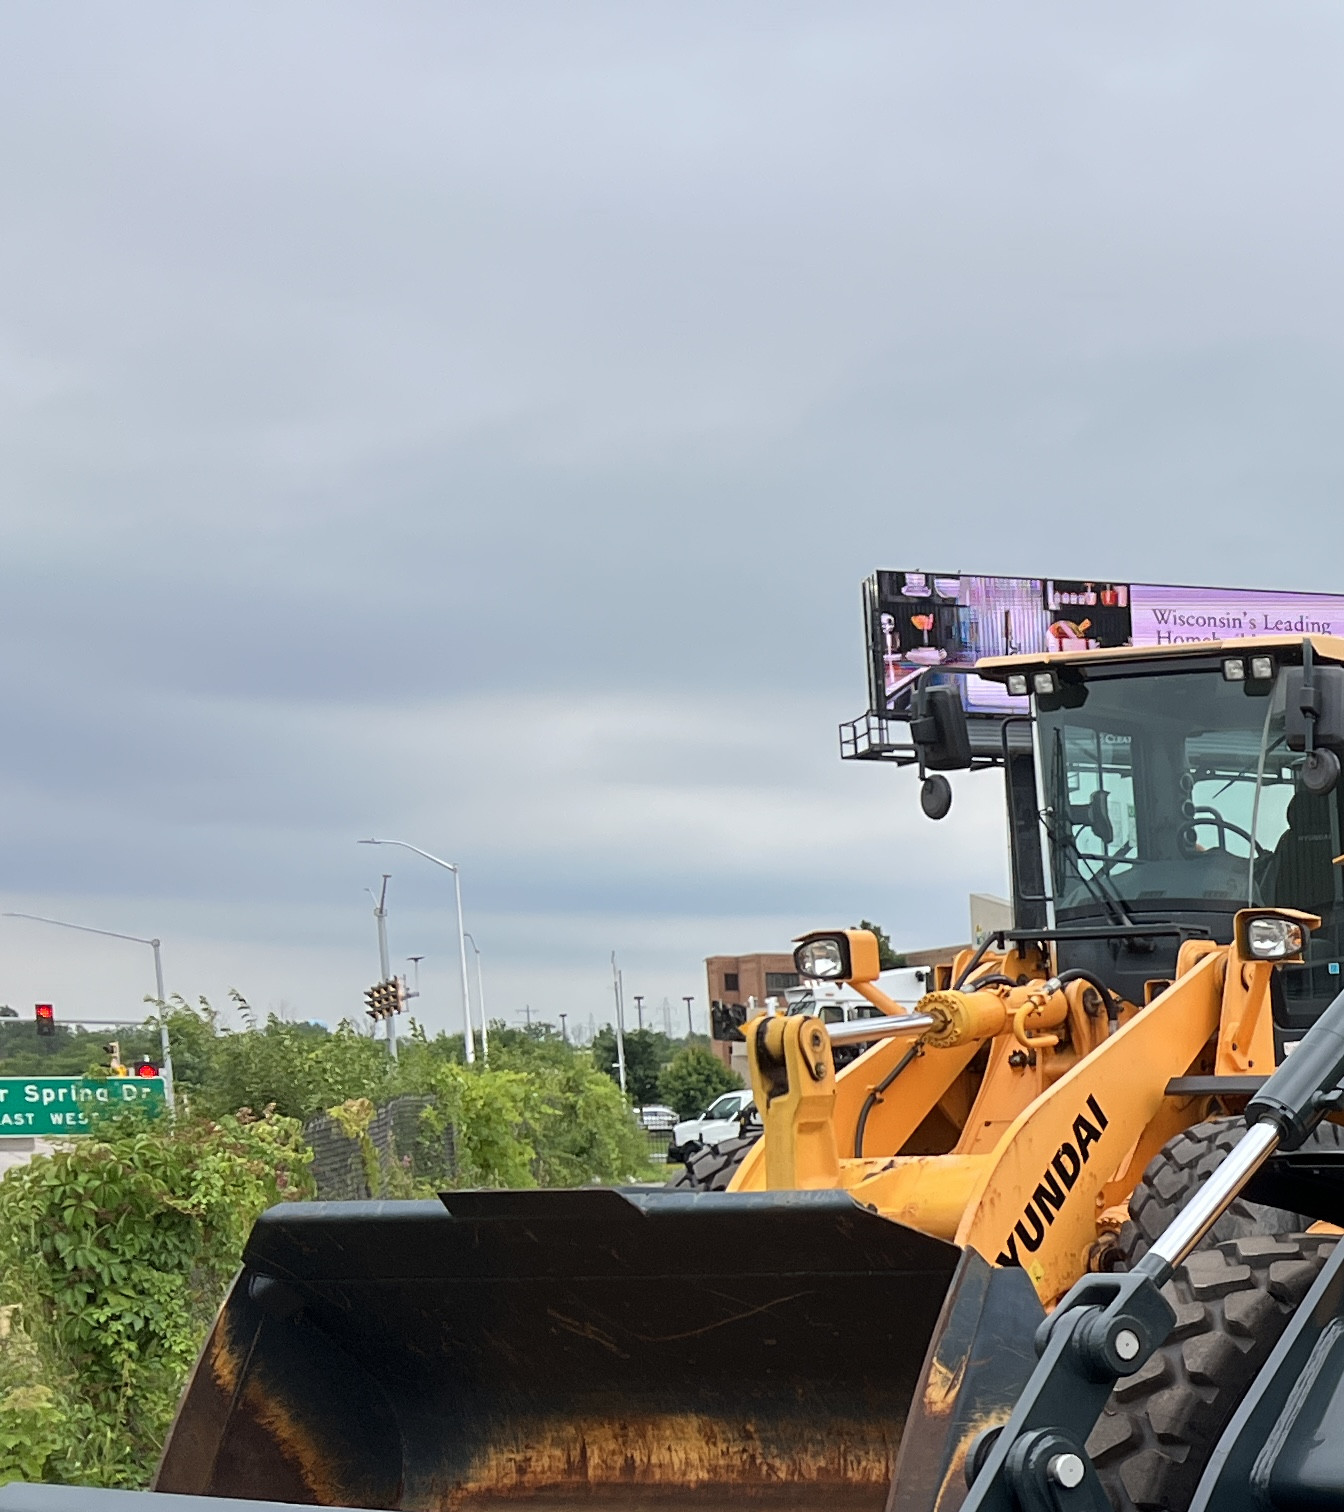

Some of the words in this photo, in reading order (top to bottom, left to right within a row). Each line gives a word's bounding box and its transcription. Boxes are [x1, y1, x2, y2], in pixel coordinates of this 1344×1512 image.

[1152, 608, 1257, 631] Wisconsin's
[1263, 614, 1332, 635] Leading
[24, 1083, 109, 1106] Spring
[122, 1083, 151, 1102] Dr
[0, 1112, 35, 1126] AST
[996, 1093, 1109, 1267] YUNDAI
